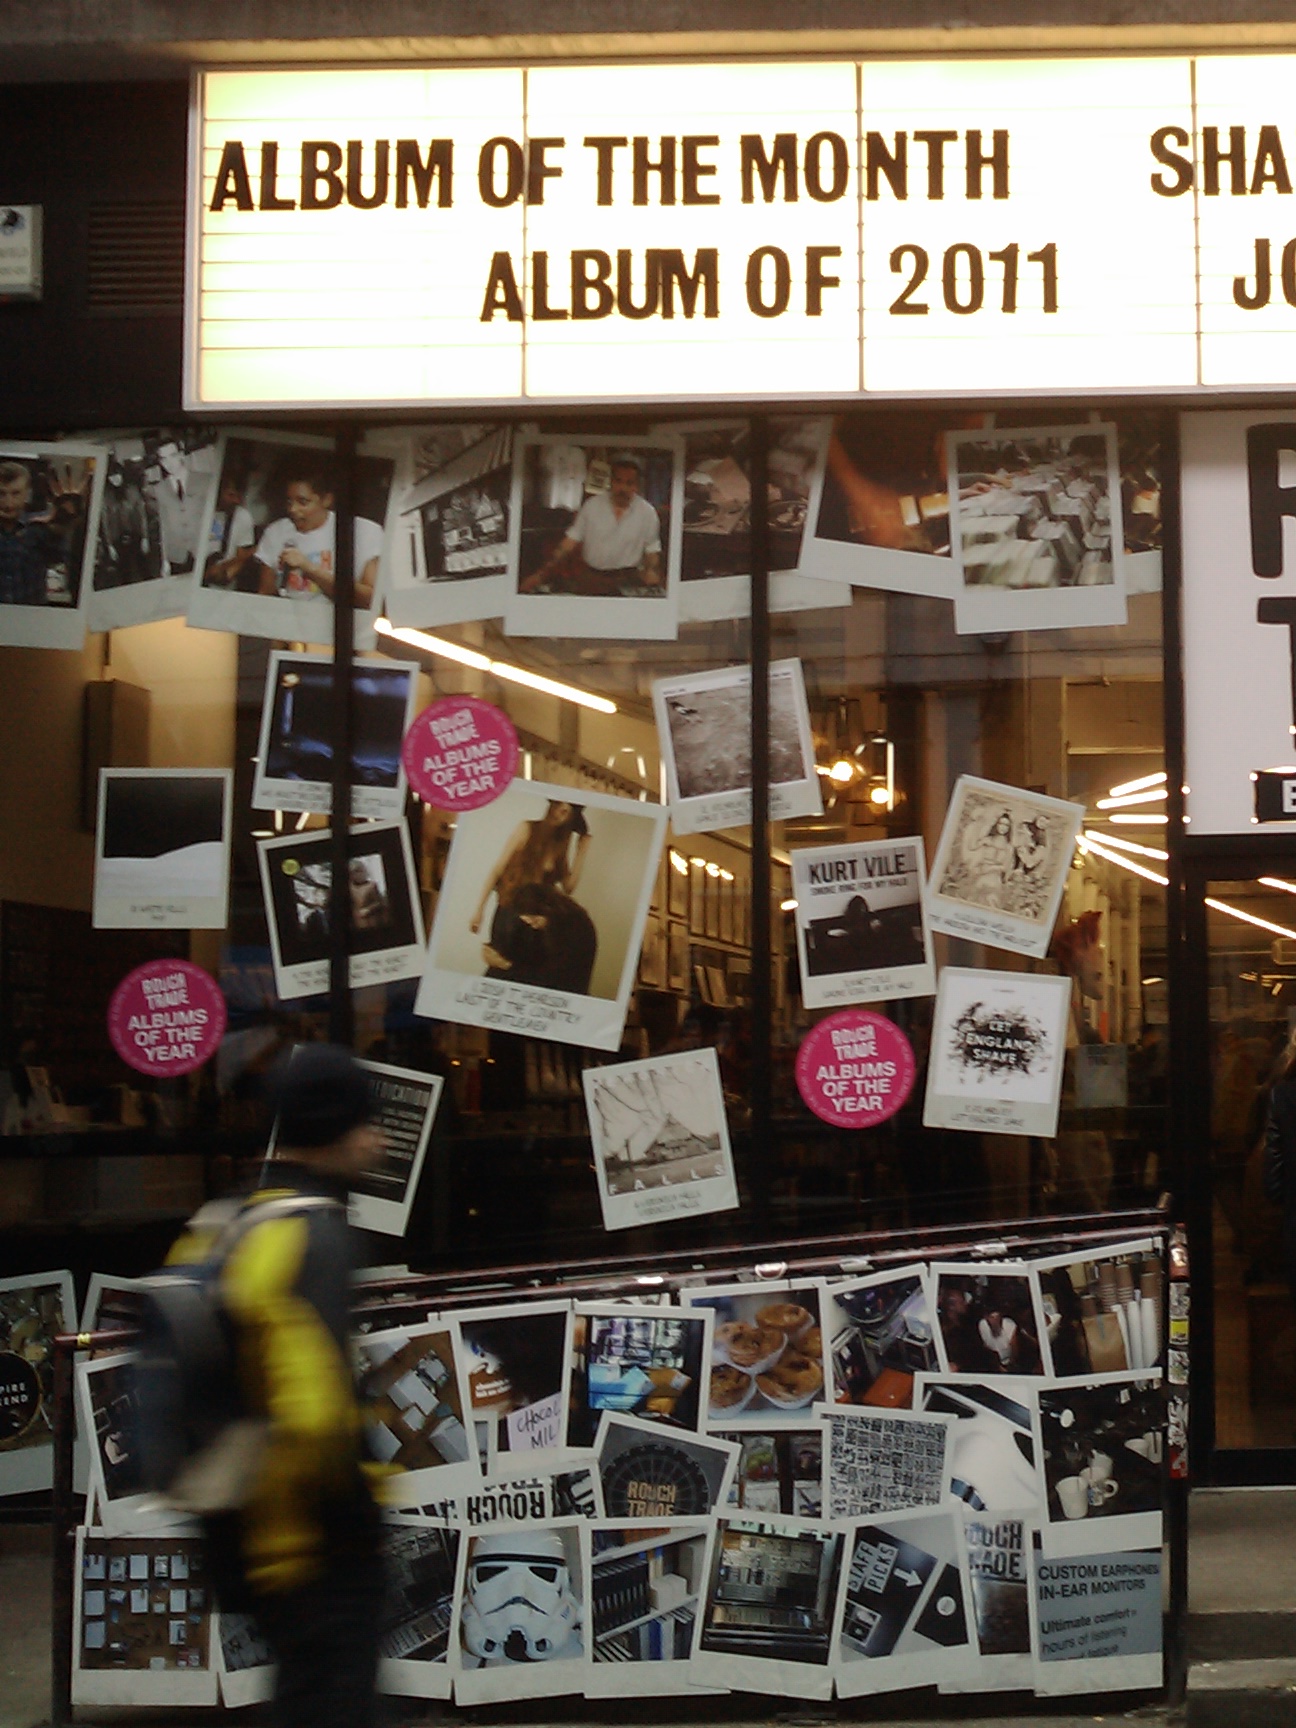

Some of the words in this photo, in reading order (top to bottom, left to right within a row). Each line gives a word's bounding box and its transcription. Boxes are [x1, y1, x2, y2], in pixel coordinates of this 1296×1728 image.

[209, 139, 455, 212] ALBUM
[478, 136, 565, 209] OF
[583, 134, 721, 206] THE
[740, 129, 1011, 204] MONTH
[480, 248, 720, 322] ALBUM
[745, 244, 843, 318] OF
[888, 241, 1060, 316] 2011
[423, 739, 501, 773] ALBUMS
[431, 767, 457, 786] OF
[461, 757, 500, 778] THE
[443, 775, 495, 800] YEAR
[808, 859, 858, 885] KURT
[864, 854, 907, 878] VILE
[127, 1008, 209, 1031] ALBUMS
[134, 1029, 161, 1047] OF
[164, 1026, 203, 1043] THE
[966, 1033, 1035, 1050] ENGLAND
[144, 1043, 196, 1062] YEAR
[973, 1048, 1018, 1064] SHAKE
[815, 1060, 897, 1081] ALBUMS
[822, 1081, 849, 1097] OF
[852, 1078, 892, 1094] THE
[831, 1095, 884, 1113] YEAR
[627, 1480, 677, 1503] ROUGH
[867, 1546, 895, 1590] PICKS
[1038, 1565, 1098, 1580] CUSTOM
[1039, 1583, 1088, 1600] IN-EAR
